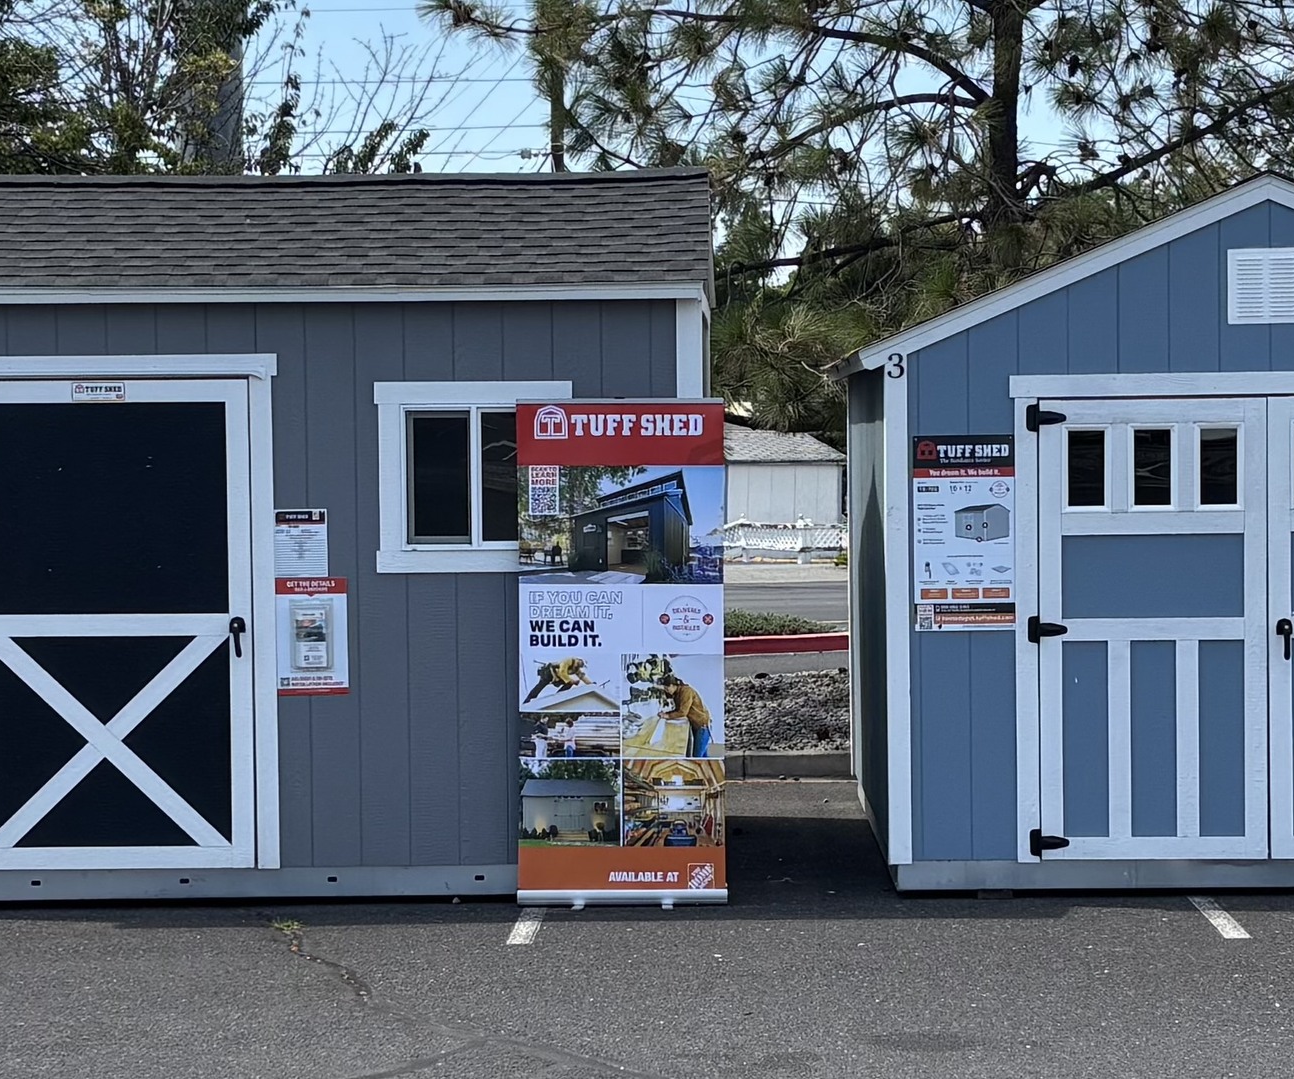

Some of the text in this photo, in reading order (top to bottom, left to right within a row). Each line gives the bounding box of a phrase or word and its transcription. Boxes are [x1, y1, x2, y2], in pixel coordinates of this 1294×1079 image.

[887, 353, 904, 378] 3
[571, 414, 704, 436] TUFF SHED
[937, 444, 1009, 457] TUFF SHED
[529, 591, 623, 604] IF YOU CAN
[529, 605, 614, 620] DREAM IT,
[529, 620, 595, 633] WE CAN
[529, 635, 602, 647] BUILD IT.
[608, 871, 679, 882] AVAILABLE AT
